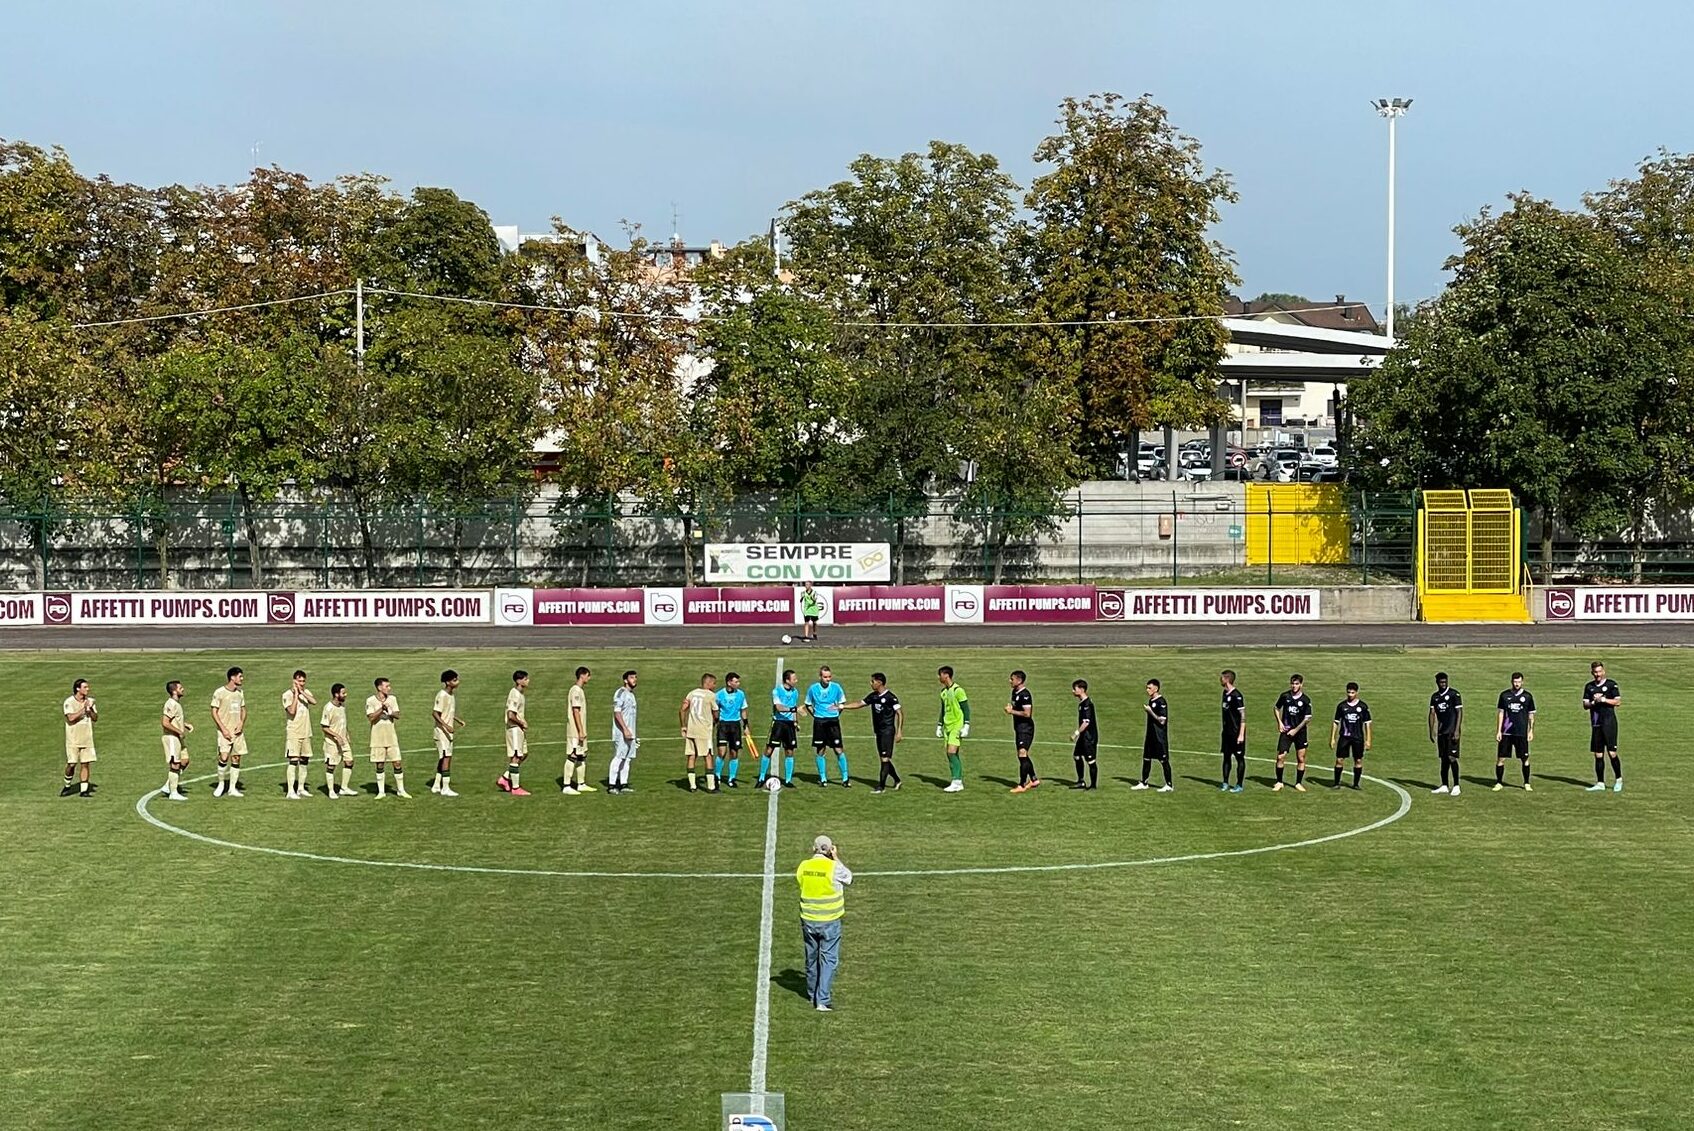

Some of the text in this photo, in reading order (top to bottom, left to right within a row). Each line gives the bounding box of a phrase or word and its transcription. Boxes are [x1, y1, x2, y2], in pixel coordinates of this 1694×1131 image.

[746, 545, 852, 560] SEMPRE
[747, 564, 852, 579] CON VOI
[81, 599, 258, 618] AFFETTI PUMPS.COM
[304, 598, 481, 617] AFFETTI PUMPS.COM
[538, 600, 640, 614] AFFETTI PUMPS.COM
[688, 599, 790, 613] AFFETTI PUMPS.COM
[838, 598, 941, 612] AFFETTI PUMPS.COM
[988, 597, 1091, 611] AFFETTI PUMPS.COM
[1133, 595, 1310, 615] AFFETTI PUMPS.COM
[1584, 594, 1649, 613] AFFETTI
